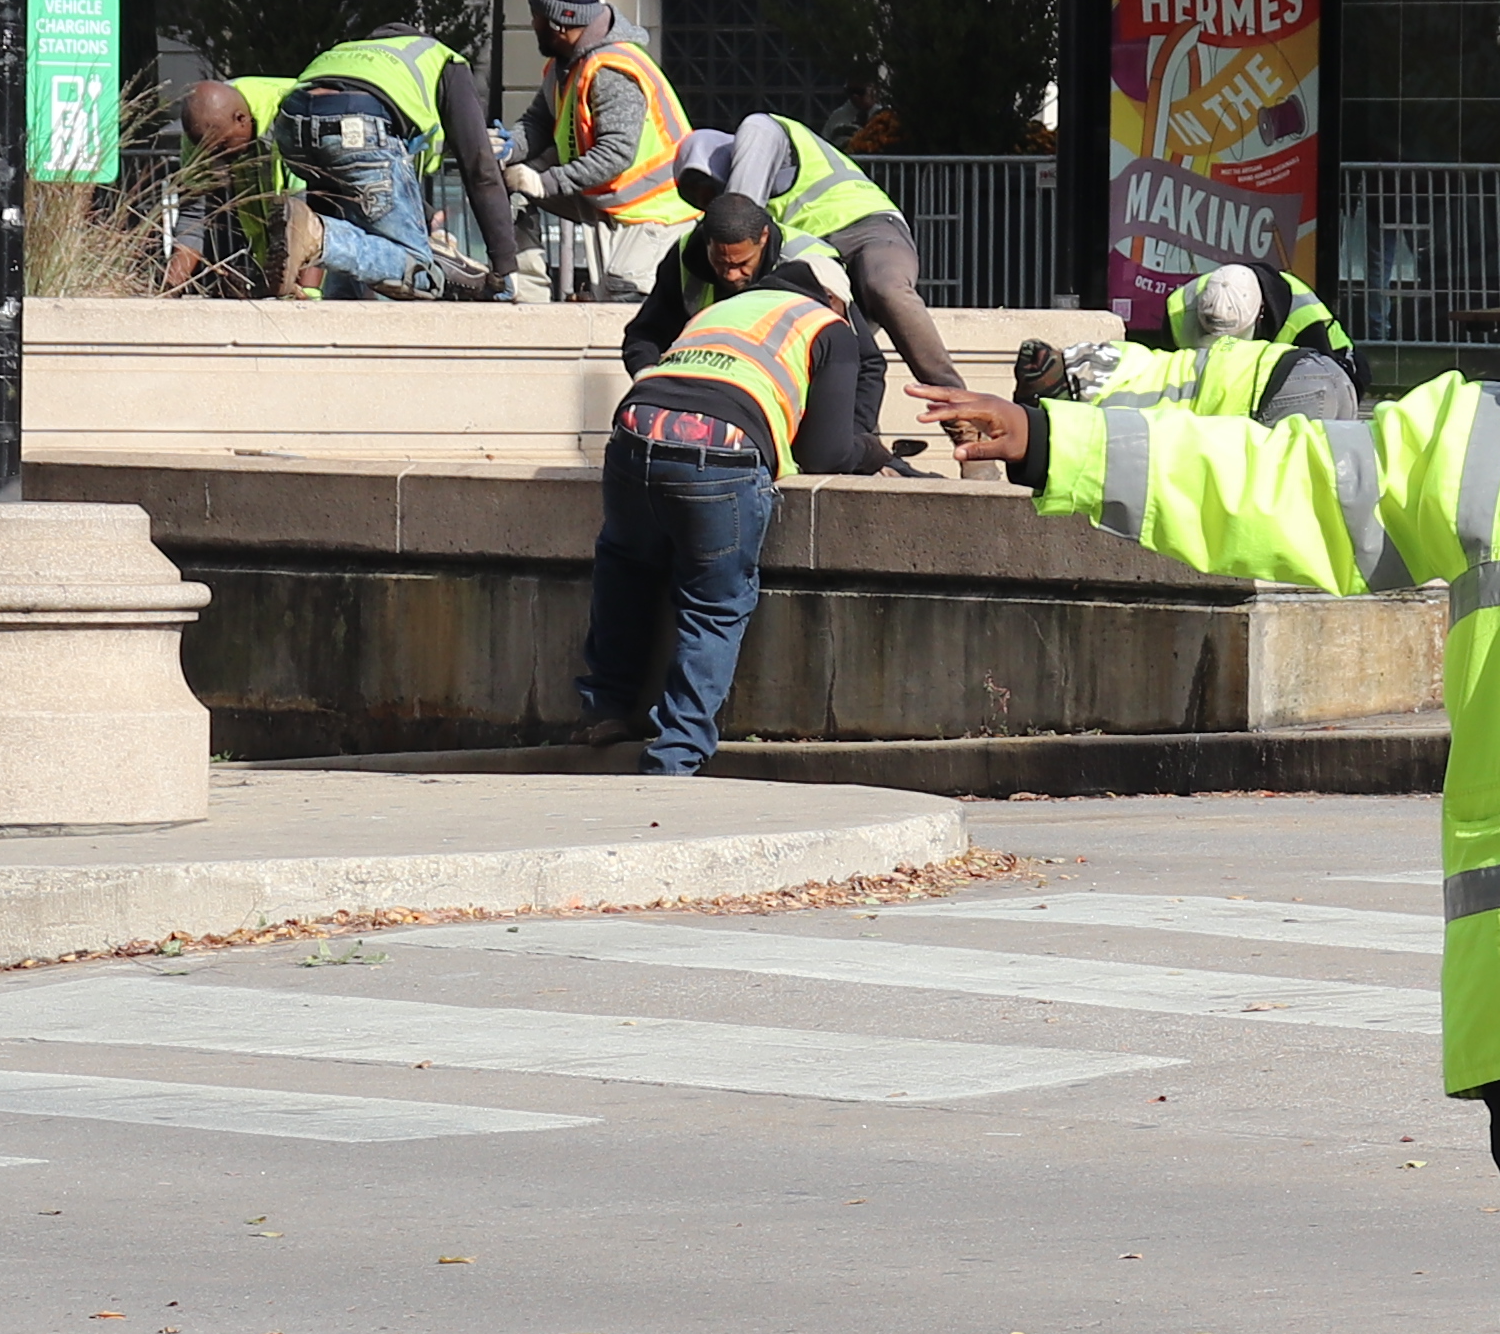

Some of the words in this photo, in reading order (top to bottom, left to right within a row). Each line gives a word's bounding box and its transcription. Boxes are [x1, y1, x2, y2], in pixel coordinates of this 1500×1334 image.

[35, 17, 111, 37] CHARGING
[38, 37, 109, 56] STATIONS
[1168, 108, 1213, 147] IN
[1202, 51, 1284, 133] THE
[1125, 170, 1275, 260] MAKING
[1134, 275, 1153, 291] OCT.
[1155, 281, 1166, 294] 27
